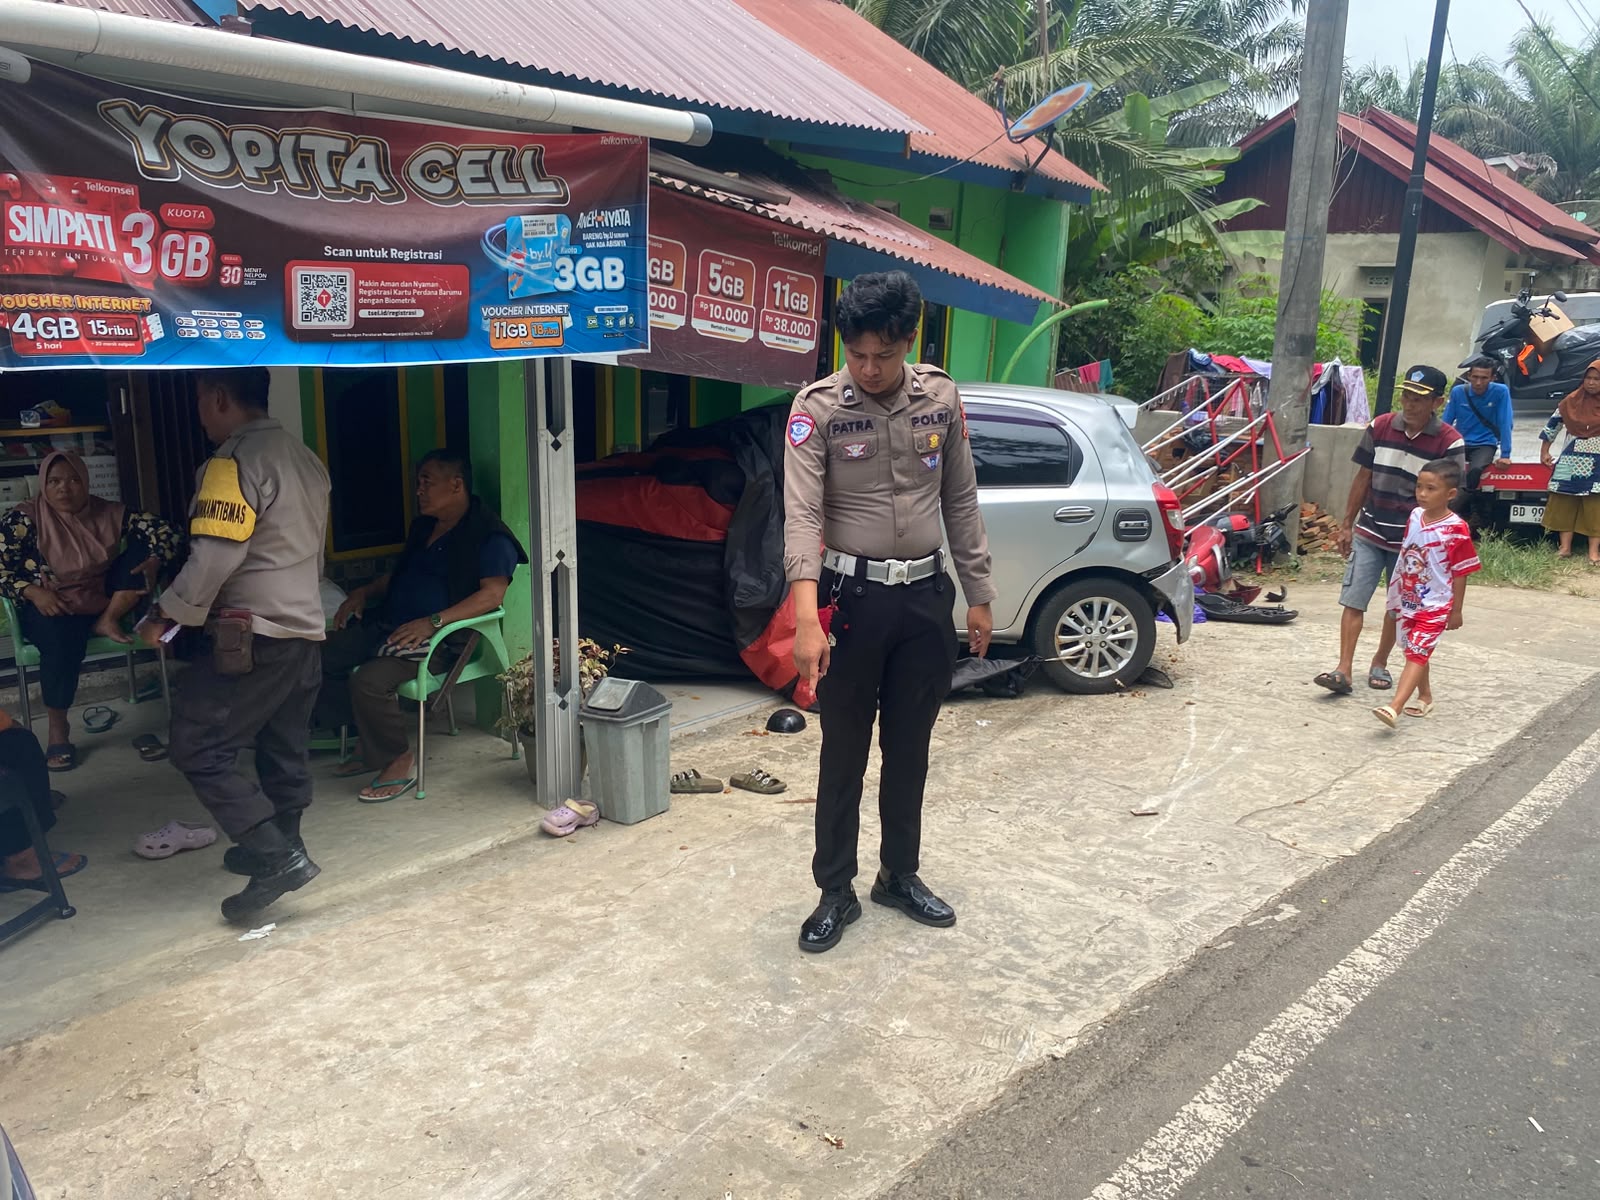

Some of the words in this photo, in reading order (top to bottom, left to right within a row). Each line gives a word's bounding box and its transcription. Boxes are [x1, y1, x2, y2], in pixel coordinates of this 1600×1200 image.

[600, 134, 643, 145] Telkomsel
[100, 101, 402, 202] YOPITA
[404, 143, 567, 204] CELL
[85, 181, 134, 196] Telkomsel
[167, 208, 206, 219] KUOTA
[600, 208, 631, 228] NYATA
[8, 205, 117, 252] SIMPATI
[4, 248, 56, 257] TERBAIK
[772, 231, 821, 257] Telkomsel
[324, 245, 353, 257] Scan
[355, 247, 388, 259] untuk
[390, 249, 443, 261] Registrasi
[221, 266, 241, 285] 30
[554, 256, 625, 291] 3GB
[708, 262, 745, 298] 5GB
[359, 288, 392, 296] Registrasi
[413, 281, 439, 289] Nyaman
[0, 294, 74, 310] OUCHER
[77, 296, 151, 311] INTERNET
[359, 297, 384, 305] dengan
[773, 281, 809, 312] 11GB
[481, 305, 523, 317] VOUCHER
[524, 304, 569, 315] INTERNET
[709, 303, 748, 324] 10.000
[12, 312, 80, 340] 4GB
[87, 319, 134, 336] 15ribu
[493, 321, 528, 338] 11GB
[773, 317, 811, 337] 38.000
[43, 341, 63, 350] hari
[831, 420, 875, 436] PATRA
[911, 412, 949, 428] POLRI
[1512, 506, 1526, 517] BD
